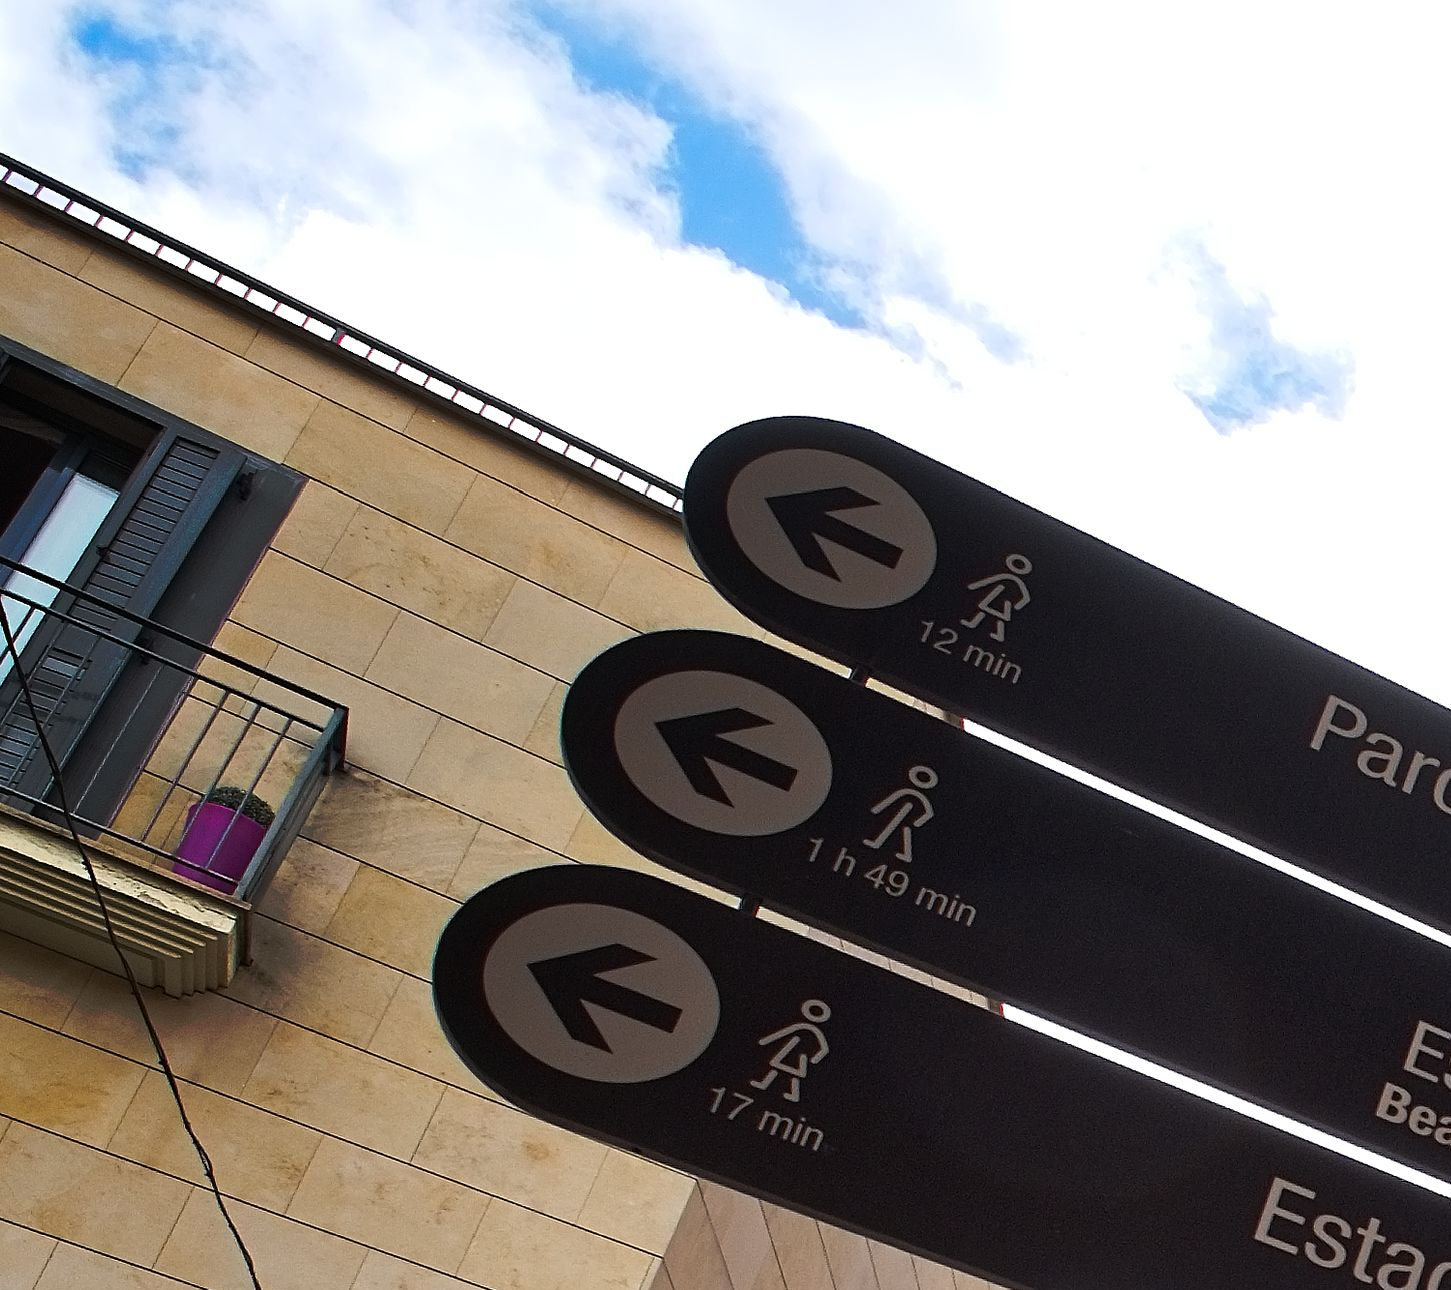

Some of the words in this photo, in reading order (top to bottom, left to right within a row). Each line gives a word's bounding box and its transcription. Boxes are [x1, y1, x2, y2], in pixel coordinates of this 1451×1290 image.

[921, 621, 958, 654] 12
[963, 645, 1021, 683] min
[810, 839, 823, 862] 1
[833, 848, 856, 876] h
[865, 865, 909, 896] 49
[916, 888, 976, 926] min
[711, 1088, 754, 1120] 17
[758, 1111, 823, 1151] min
